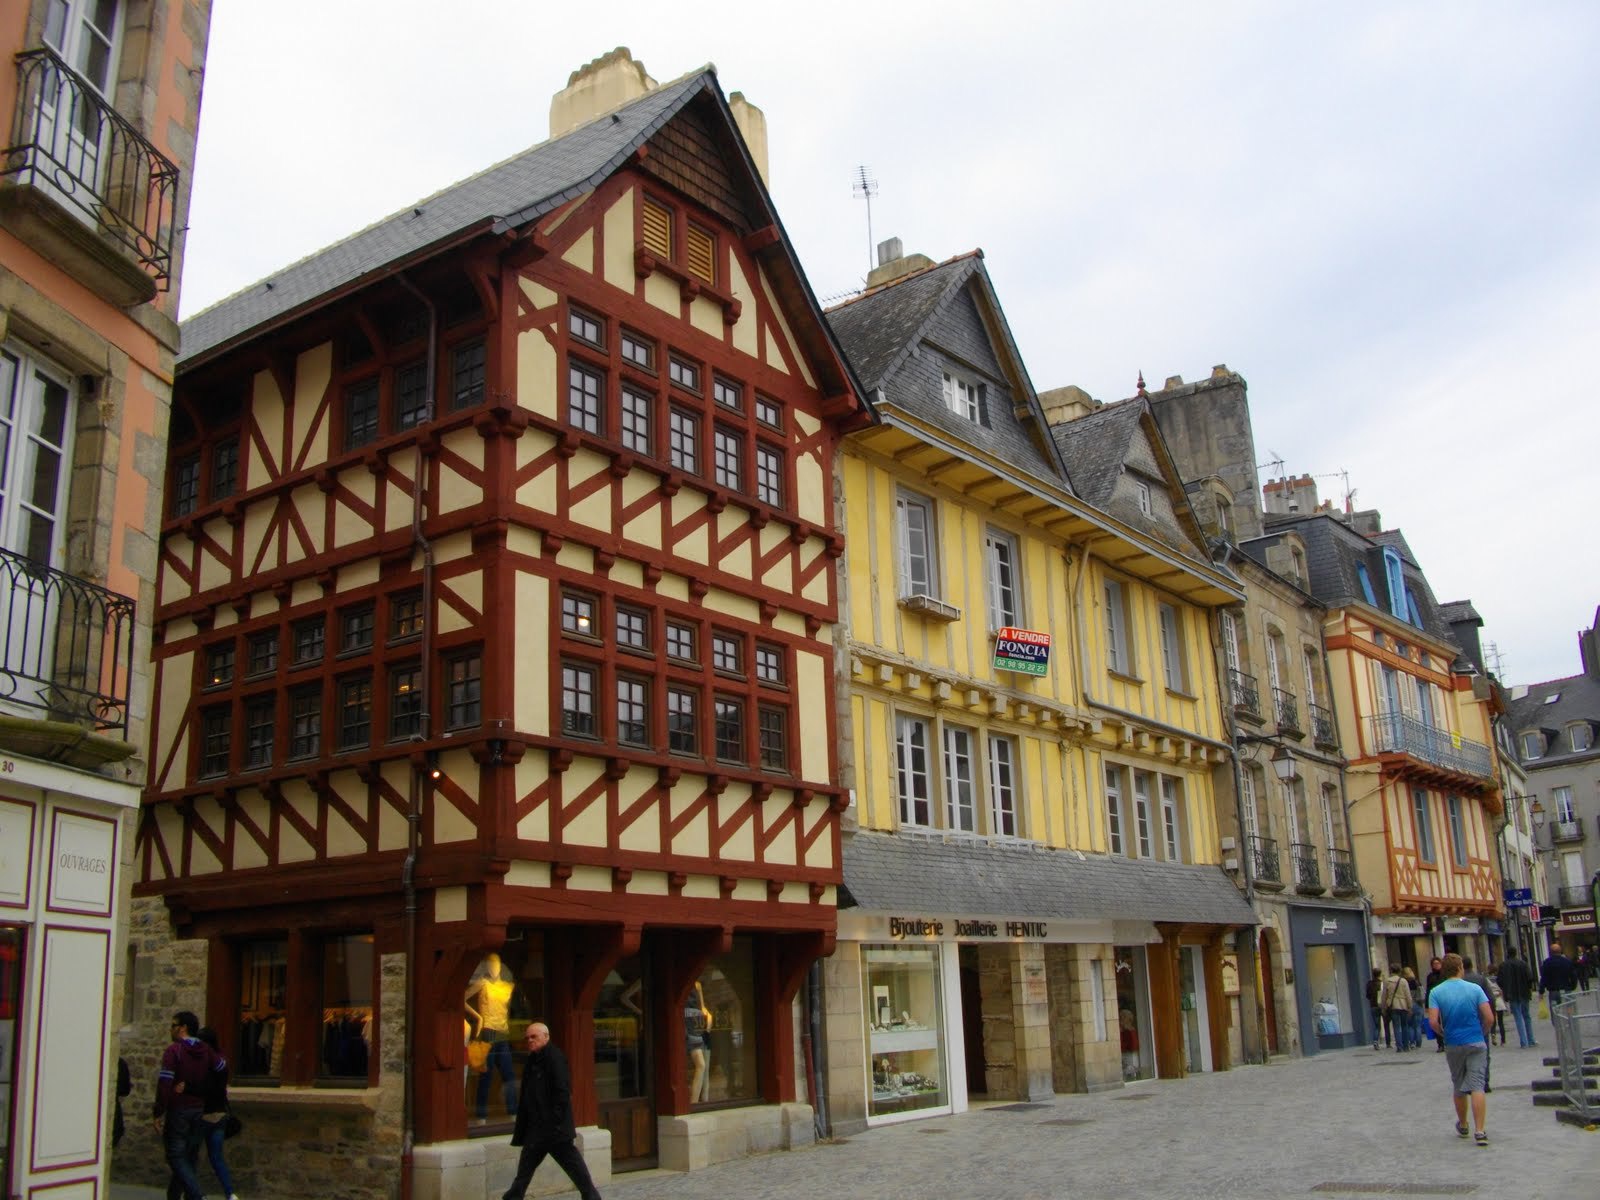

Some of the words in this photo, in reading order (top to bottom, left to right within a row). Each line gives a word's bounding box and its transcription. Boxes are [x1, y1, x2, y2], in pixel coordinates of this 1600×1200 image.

[1000, 629, 1008, 638] A
[1011, 630, 1050, 644] VENDRE
[998, 640, 1047, 657] FONCIA
[2, 761, 14, 774] 30
[60, 853, 106, 874] OUVRAGES
[1568, 914, 1591, 922] TEXTO
[890, 917, 944, 939] Bijouterie
[954, 919, 998, 937] Joaillerie
[1006, 922, 1048, 938] HENTIC
